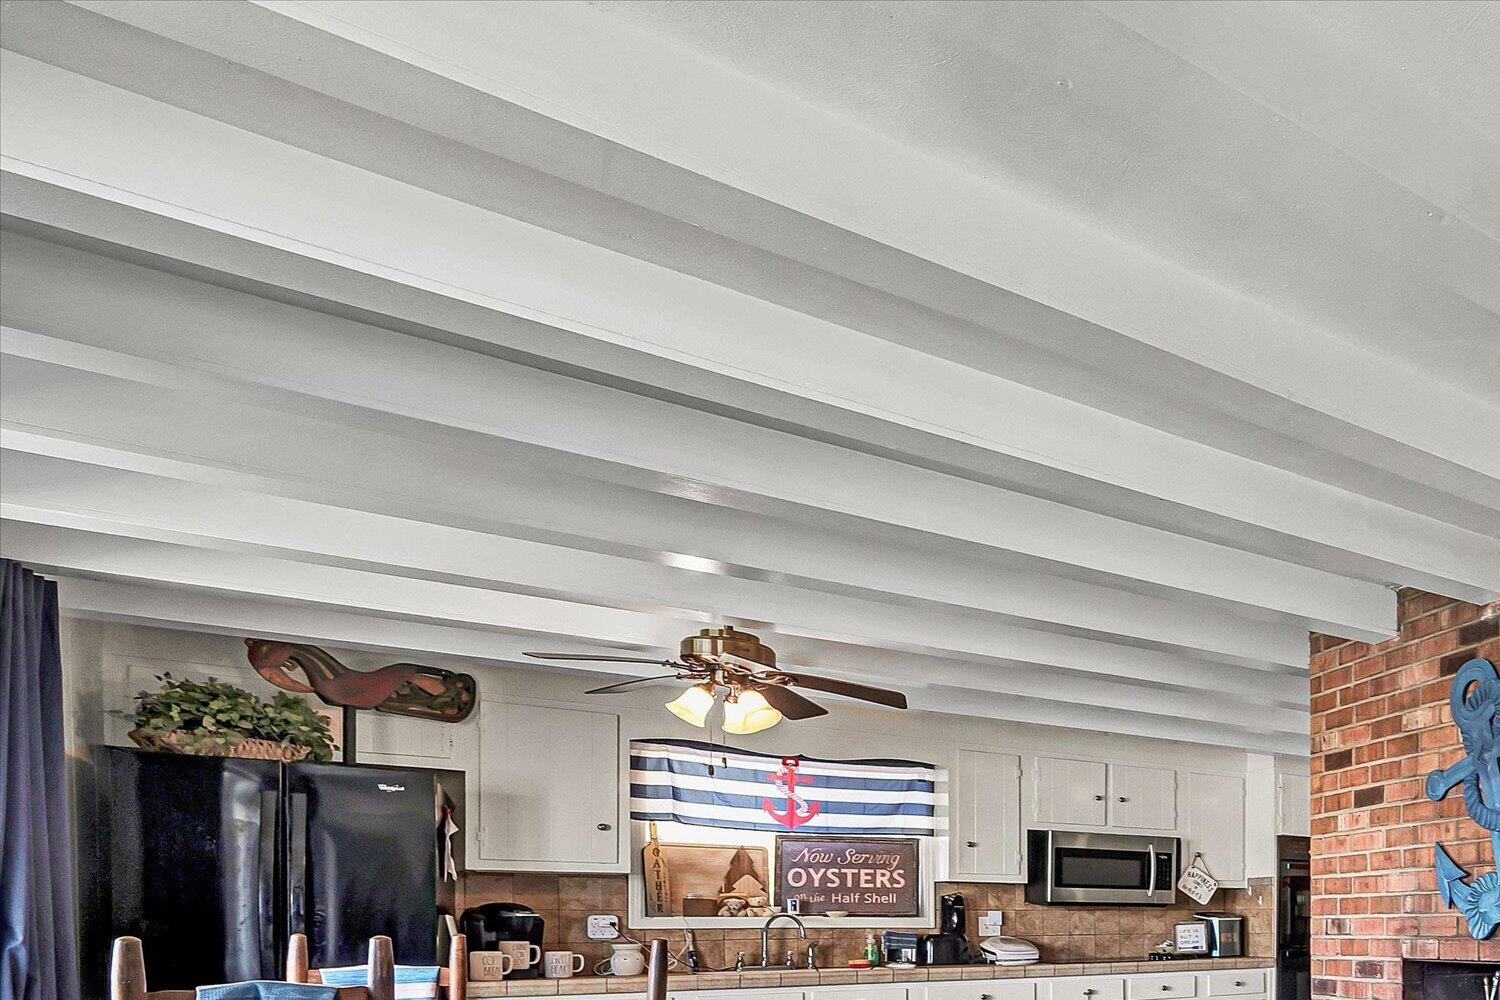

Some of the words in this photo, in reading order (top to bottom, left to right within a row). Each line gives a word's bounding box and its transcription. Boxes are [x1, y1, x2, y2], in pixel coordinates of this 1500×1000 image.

[790, 847, 834, 864] Now
[837, 848, 900, 871] Serving
[652, 847, 664, 913] GATHER
[787, 867, 906, 888] OYSTERS
[809, 892, 826, 903] the
[831, 893, 861, 904] Half
[864, 893, 897, 904] Shell
